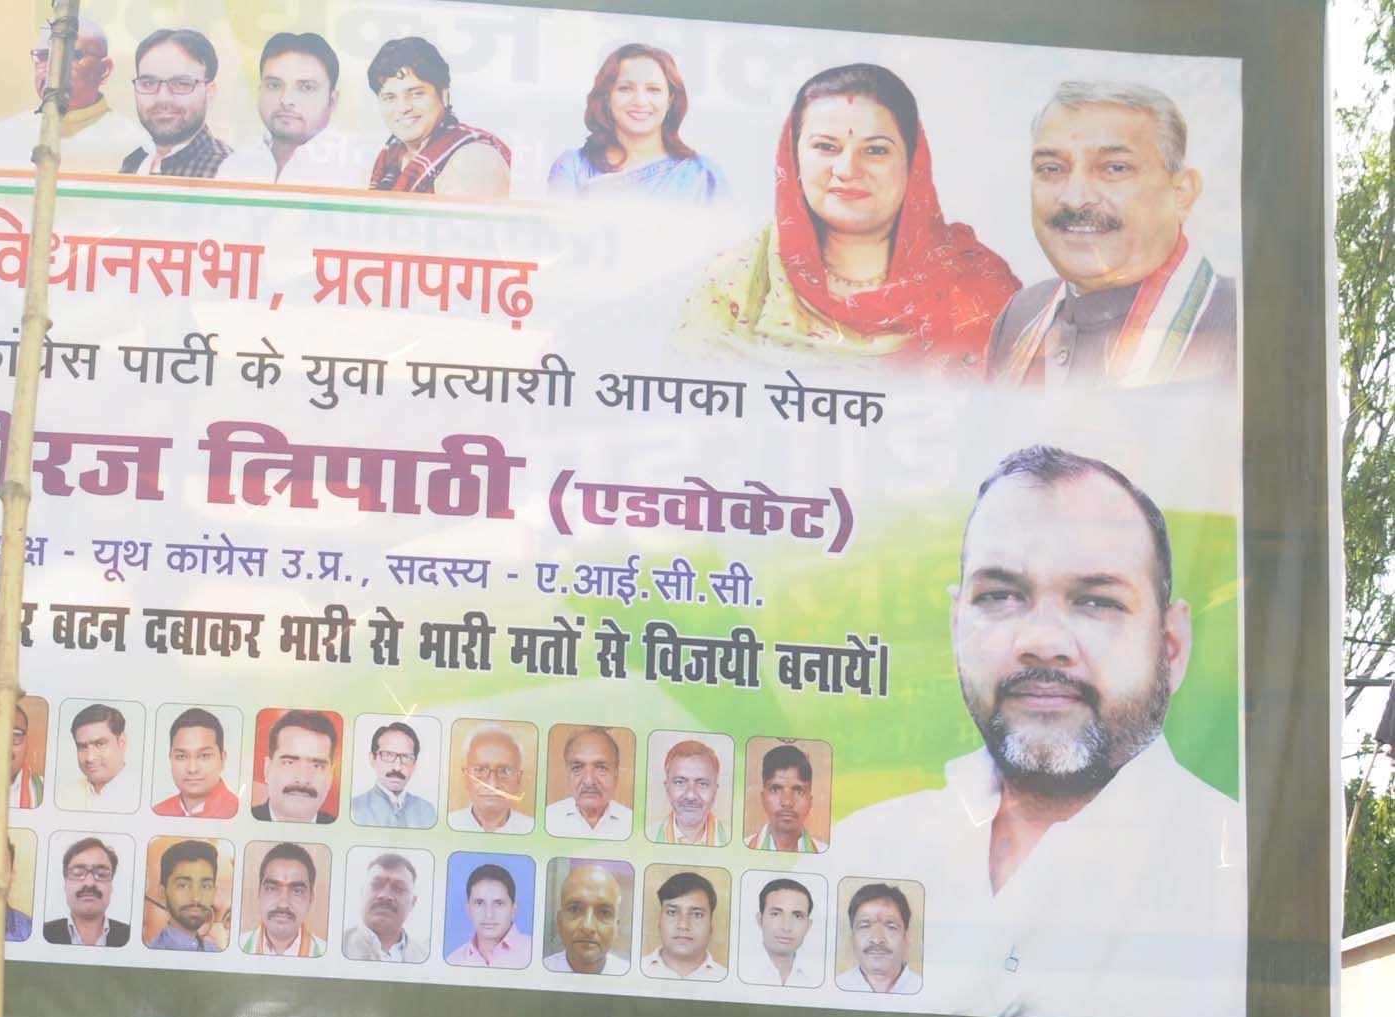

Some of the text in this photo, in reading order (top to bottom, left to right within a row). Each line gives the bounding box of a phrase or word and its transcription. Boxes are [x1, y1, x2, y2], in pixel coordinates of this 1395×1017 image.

[313, 248, 538, 330] प्रतापगढ़
[118, 333, 219, 386] पार्टी
[237, 337, 284, 389] के
[302, 355, 388, 410] युवा
[406, 353, 575, 407] प्रत्याशी
[595, 373, 747, 418] आपका
[765, 370, 886, 427] सेवक
[198, 421, 527, 519] त्रिपाठी
[549, 470, 854, 553] (एडवोकेट)
[92, 538, 152, 582] यूथ
[166, 532, 268, 577] कांग्रेस
[386, 555, 491, 588] सदस्य
[49, 604, 130, 652] बटन
[143, 608, 265, 658] दबाकर
[279, 604, 356, 663] भारी
[368, 606, 404, 666] से
[419, 611, 496, 670] भारी
[507, 615, 585, 675] मतों
[595, 619, 630, 678] से
[642, 621, 764, 687] विजयी
